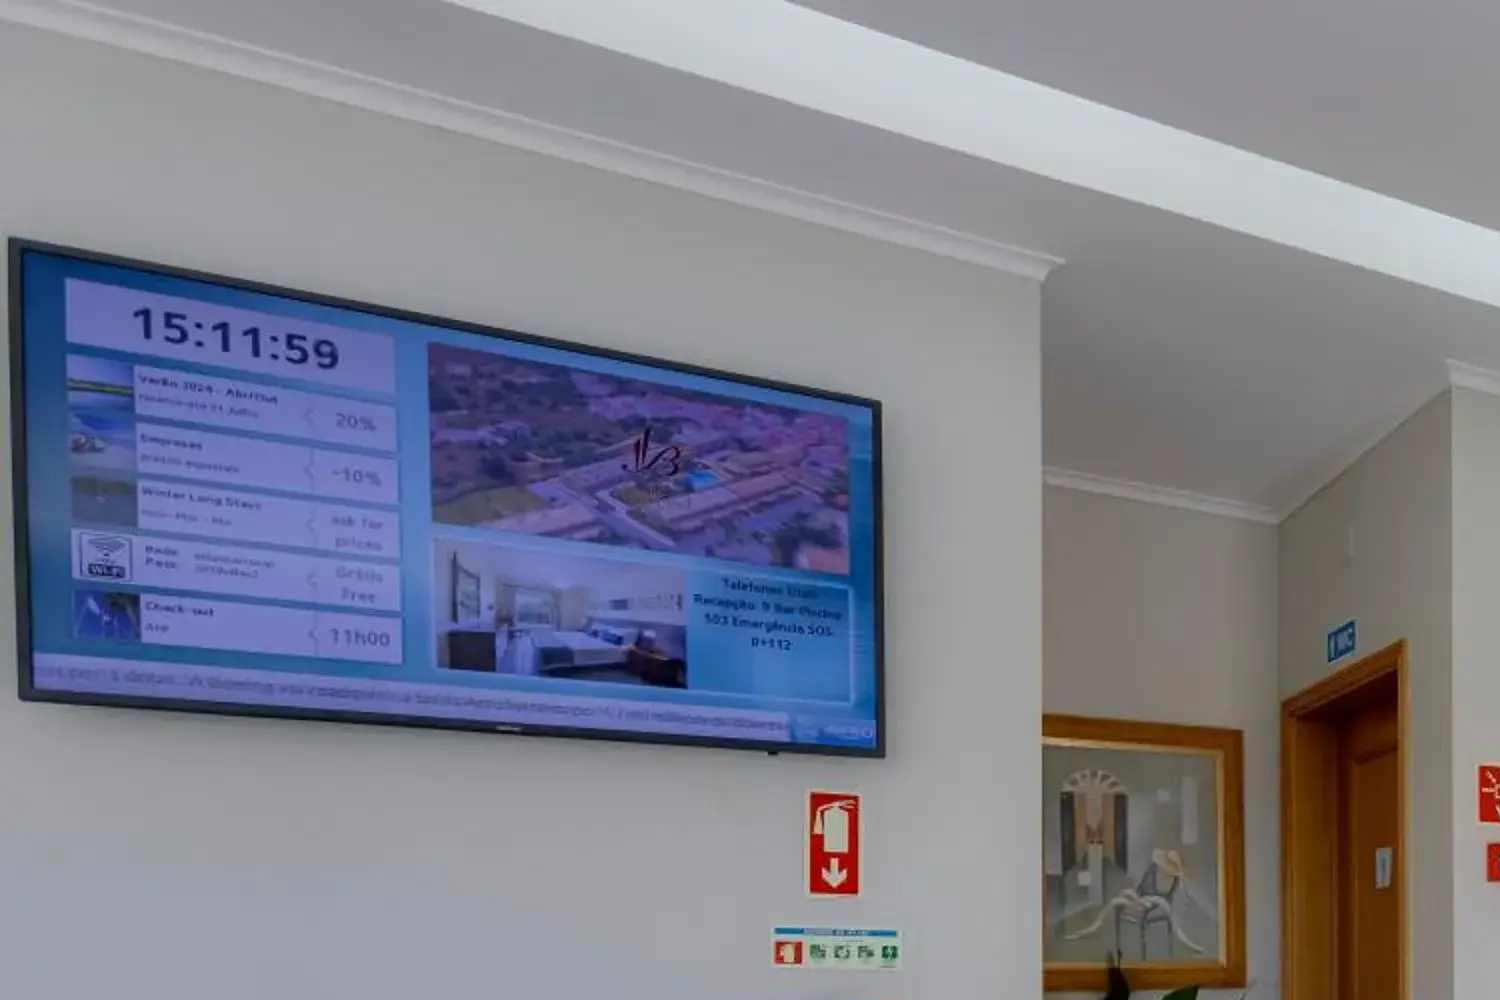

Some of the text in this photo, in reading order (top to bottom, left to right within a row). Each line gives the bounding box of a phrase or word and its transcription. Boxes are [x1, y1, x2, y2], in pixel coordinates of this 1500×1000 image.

[132, 307, 340, 370] 15:11:59
[335, 412, 378, 432] 20%
[330, 467, 383, 487] -10%
[330, 628, 392, 649] 11h00
